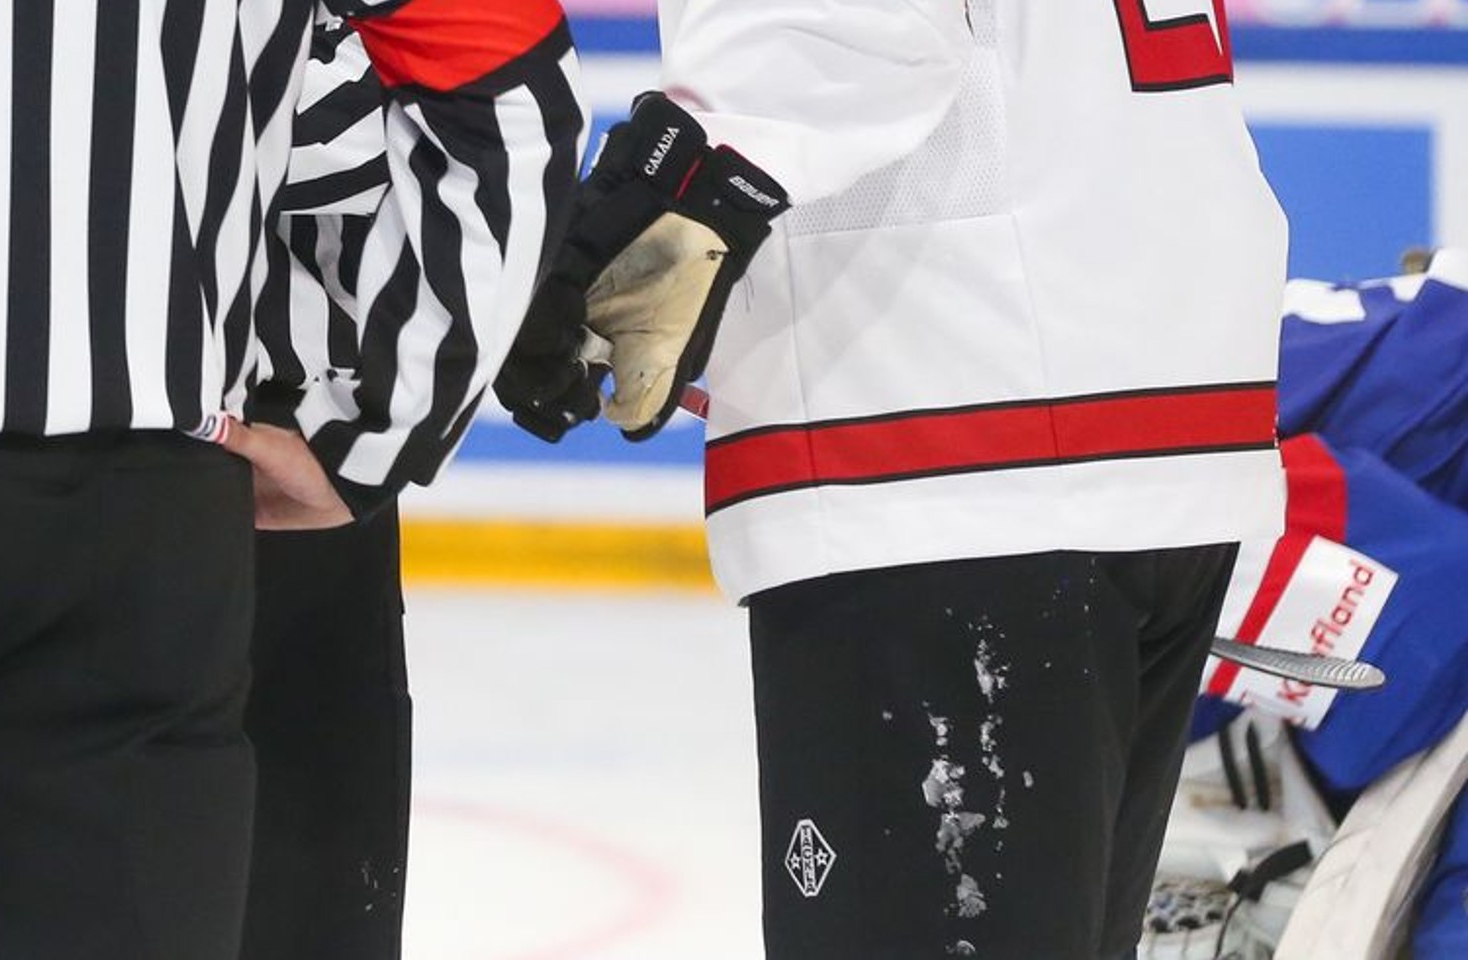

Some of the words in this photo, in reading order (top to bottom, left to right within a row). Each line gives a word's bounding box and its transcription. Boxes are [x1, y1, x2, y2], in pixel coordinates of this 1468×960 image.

[644, 126, 680, 176] CANADA
[728, 175, 780, 208] BAUER
[1277, 558, 1375, 708] Kfland
